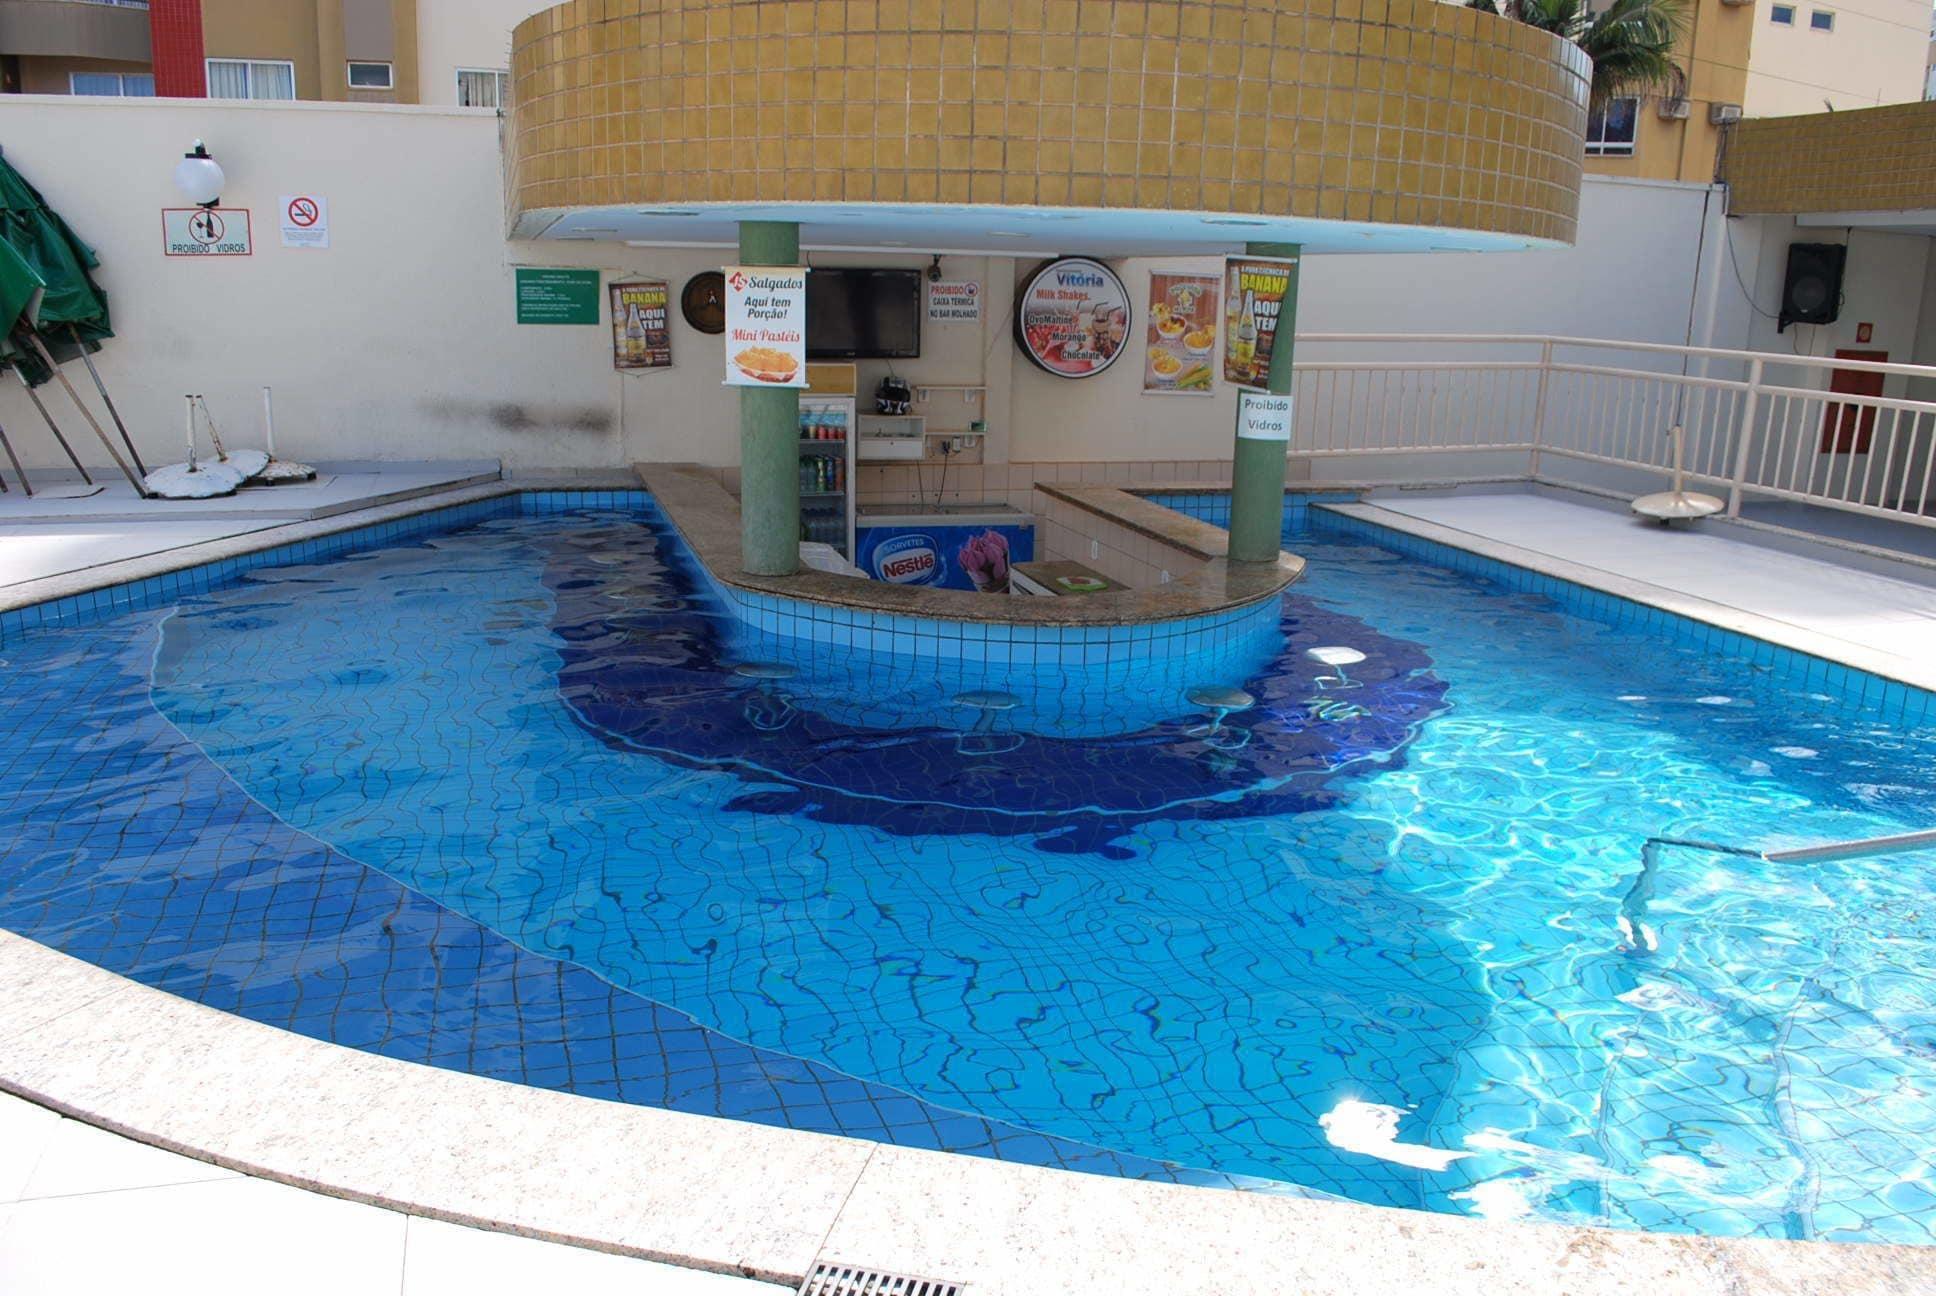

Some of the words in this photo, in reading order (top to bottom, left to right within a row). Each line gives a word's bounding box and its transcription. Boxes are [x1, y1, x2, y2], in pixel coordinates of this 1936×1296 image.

[172, 243, 210, 253] PROIBIDO
[216, 243, 246, 253] VIDROS
[749, 276, 803, 292] Salgados
[1057, 272, 1105, 287] Vitória
[1241, 273, 1289, 294] BANANA
[931, 285, 963, 295] PROIBIDO
[1036, 288, 1056, 300] Milk
[622, 291, 667, 305] BANANA
[744, 296, 768, 308] Aqui
[771, 297, 791, 307] tem
[933, 296, 950, 305] CAIXA
[640, 308, 665, 319] AQUI
[747, 309, 787, 321] Porção!
[642, 320, 664, 329] TEM
[732, 328, 757, 341] Mini
[1052, 331, 1087, 342] Morango
[1062, 350, 1100, 360] Chocolate
[1245, 398, 1288, 410] Proibido
[1248, 419, 1282, 430] Vidros
[883, 553, 933, 578] Nestlé
